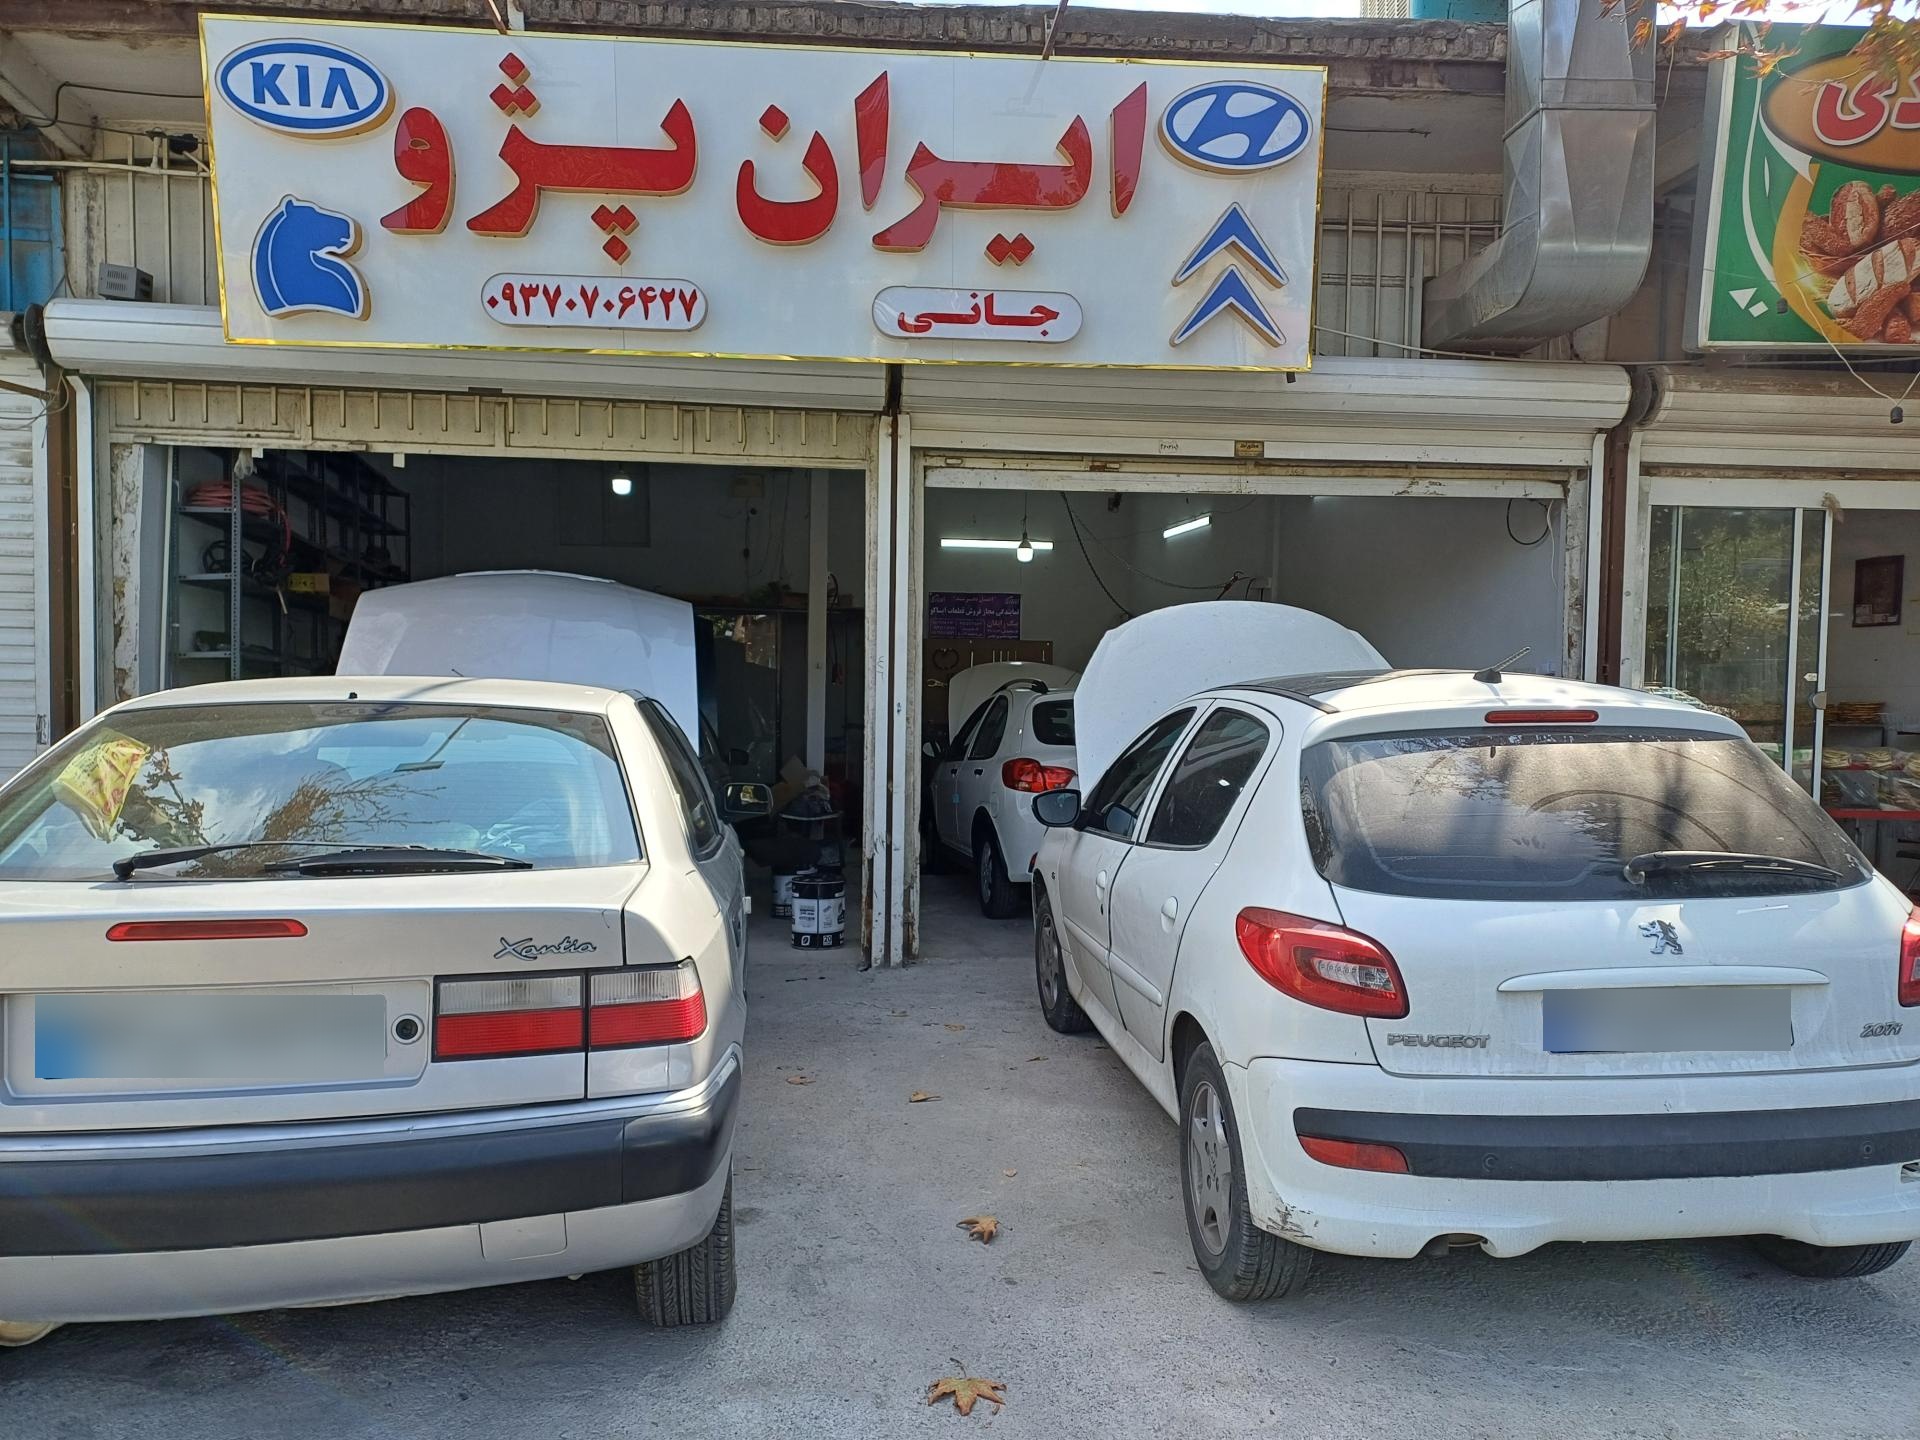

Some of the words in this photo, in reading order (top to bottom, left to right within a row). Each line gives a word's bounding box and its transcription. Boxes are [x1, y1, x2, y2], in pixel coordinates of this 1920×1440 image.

[249, 62, 361, 111] KIA
[379, 52, 699, 265] پژو
[735, 70, 1148, 266] ایران
[486, 281, 699, 323] ۰۹۳۷۰۷۰۶۴۲۷
[897, 291, 1060, 337] جانی
[493, 935, 597, 961] Xantia
[1386, 1032, 1492, 1049] PEUGEOT
